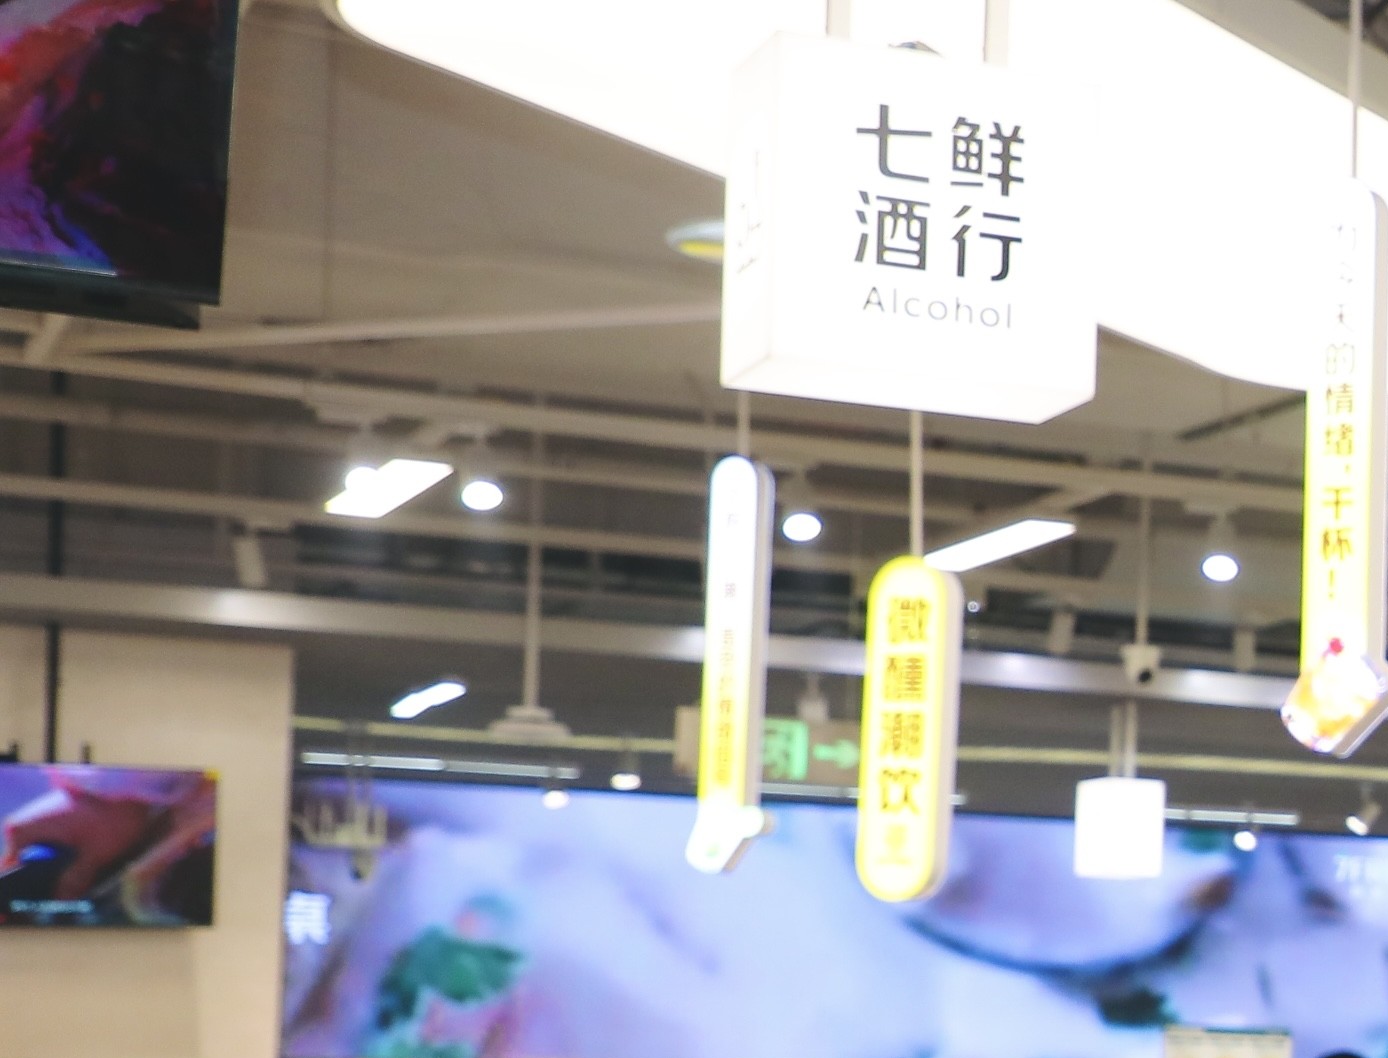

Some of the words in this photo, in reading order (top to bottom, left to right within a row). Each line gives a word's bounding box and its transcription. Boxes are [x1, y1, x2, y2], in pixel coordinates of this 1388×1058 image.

[856, 104, 1024, 197] 七鲜
[854, 190, 1022, 281] 酒行
[863, 286, 1012, 329] Alcohol
